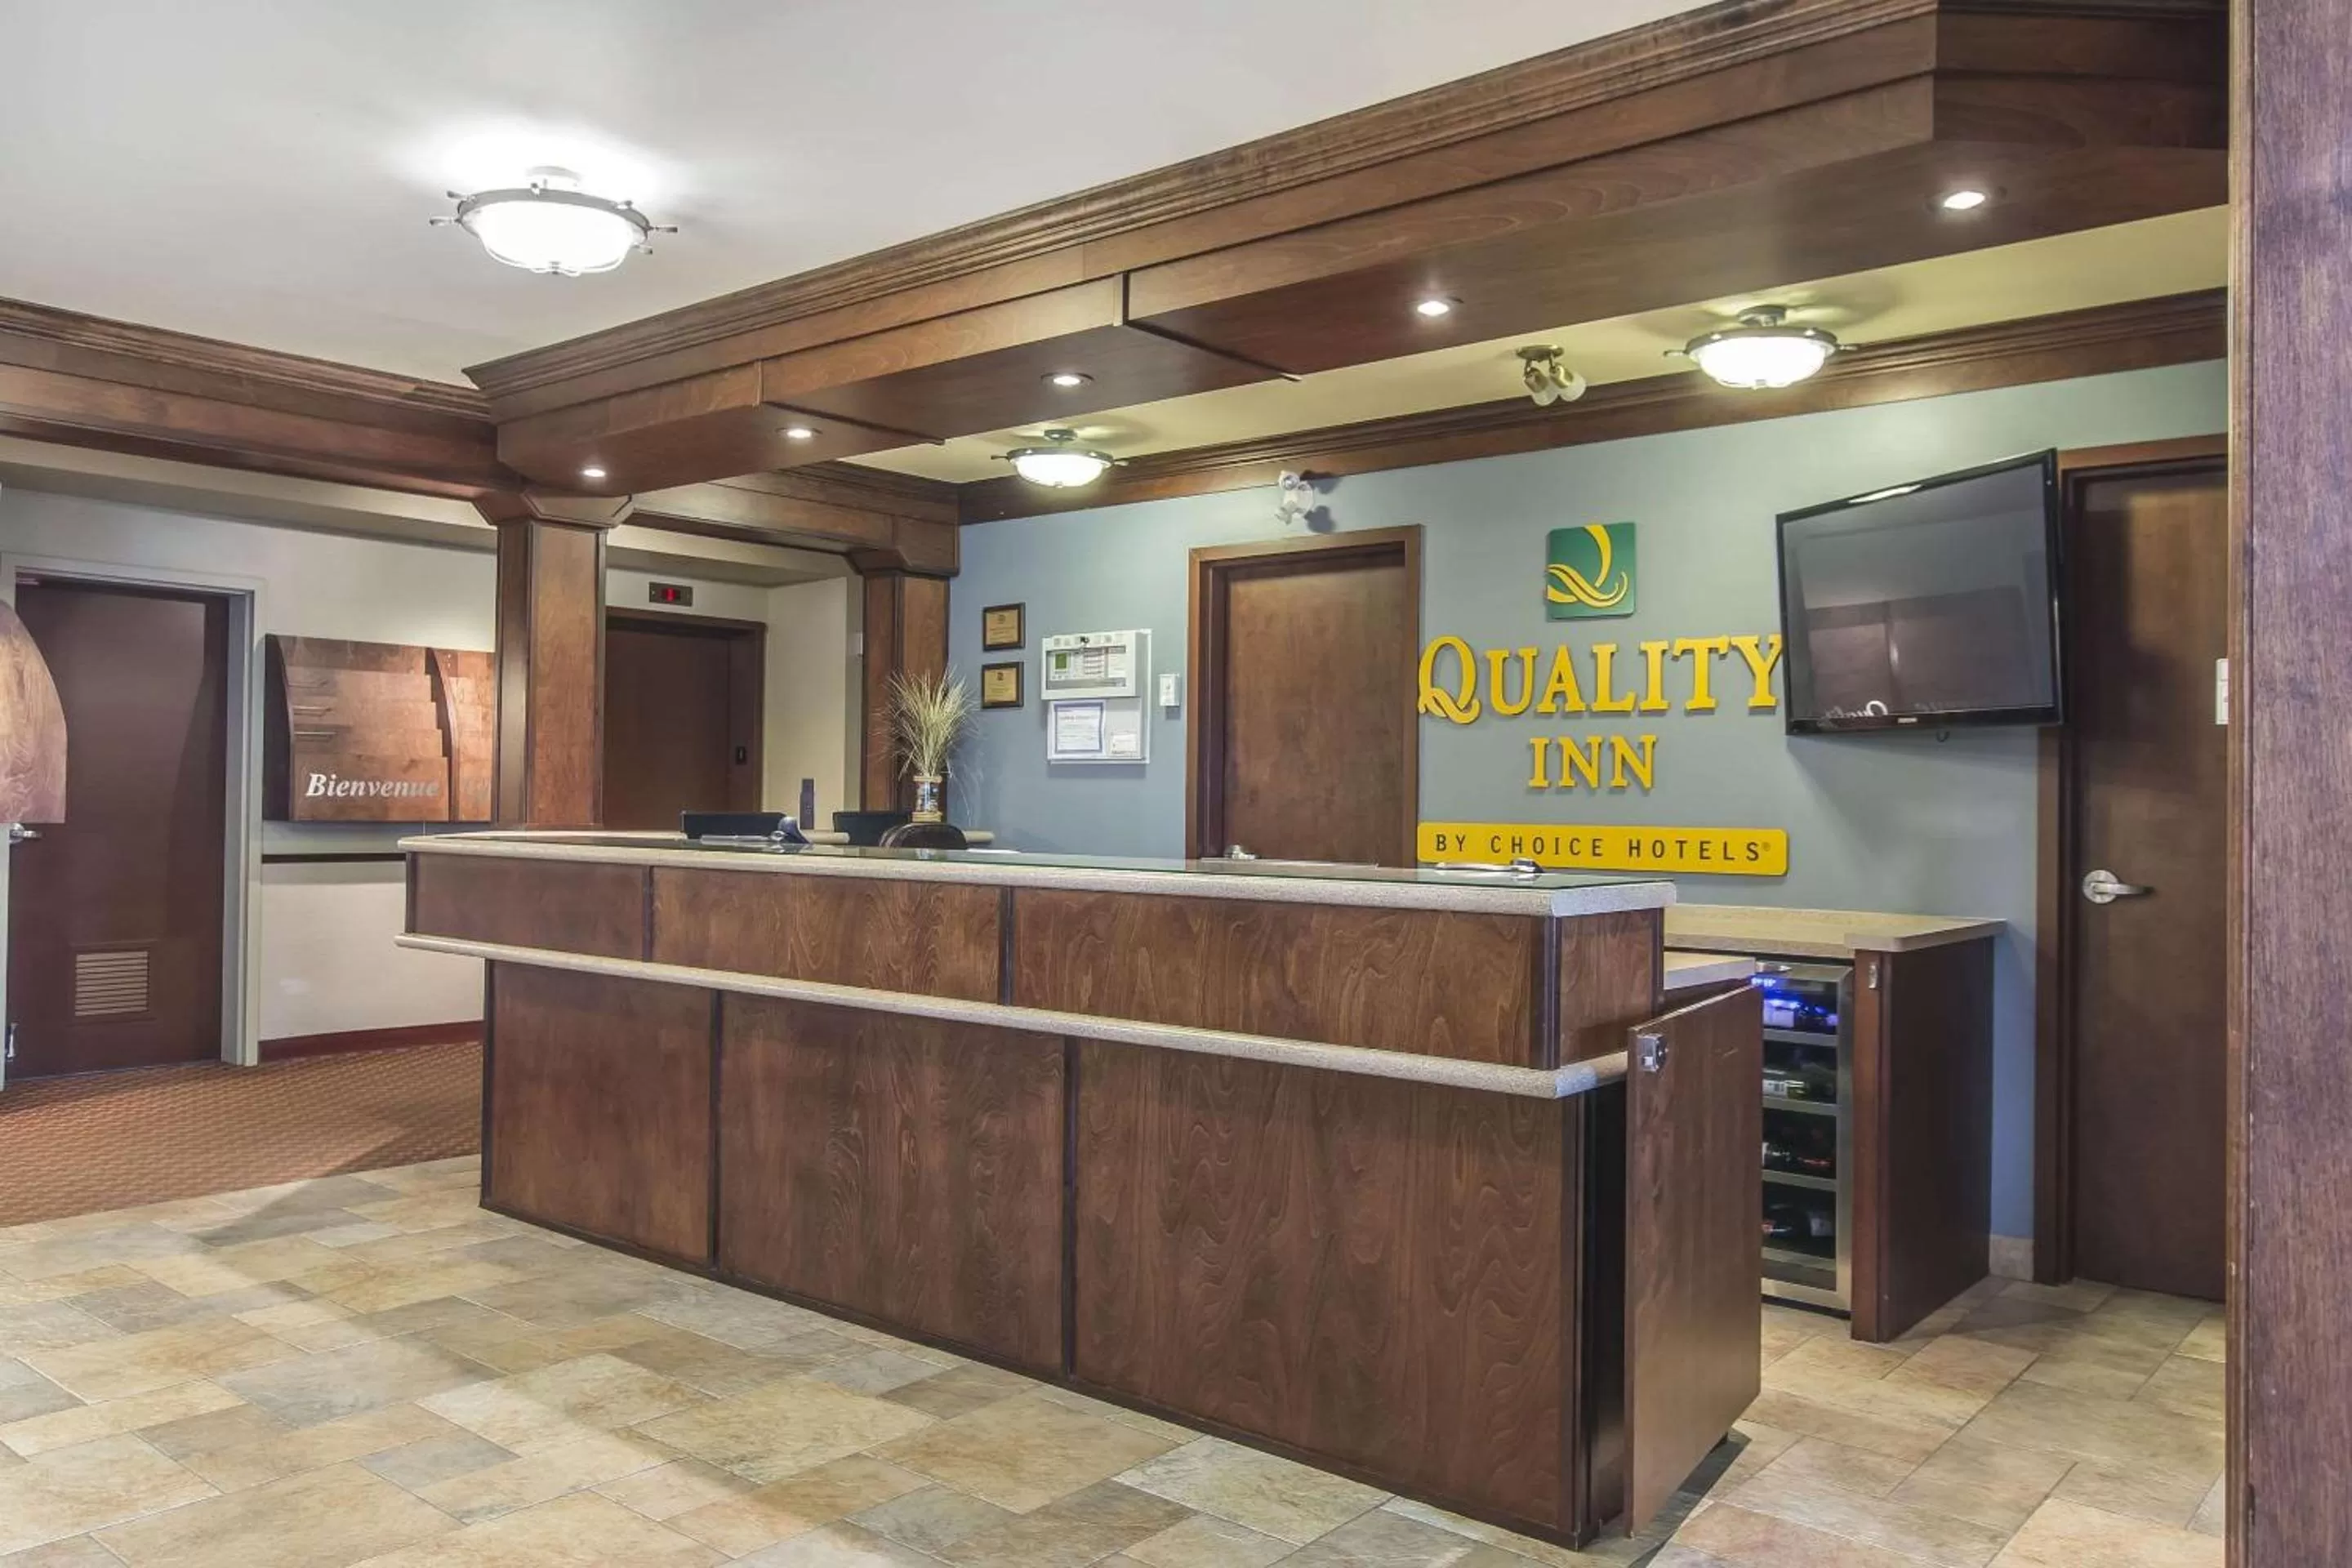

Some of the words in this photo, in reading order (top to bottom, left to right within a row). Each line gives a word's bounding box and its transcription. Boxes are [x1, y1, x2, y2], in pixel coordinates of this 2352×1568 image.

[1418, 635, 1783, 724] QUALITY
[1529, 735, 1657, 788] INN
[305, 773, 439, 797] Bienvenue
[1436, 834, 1467, 852] BY
[1490, 835, 1604, 856] CHOICE
